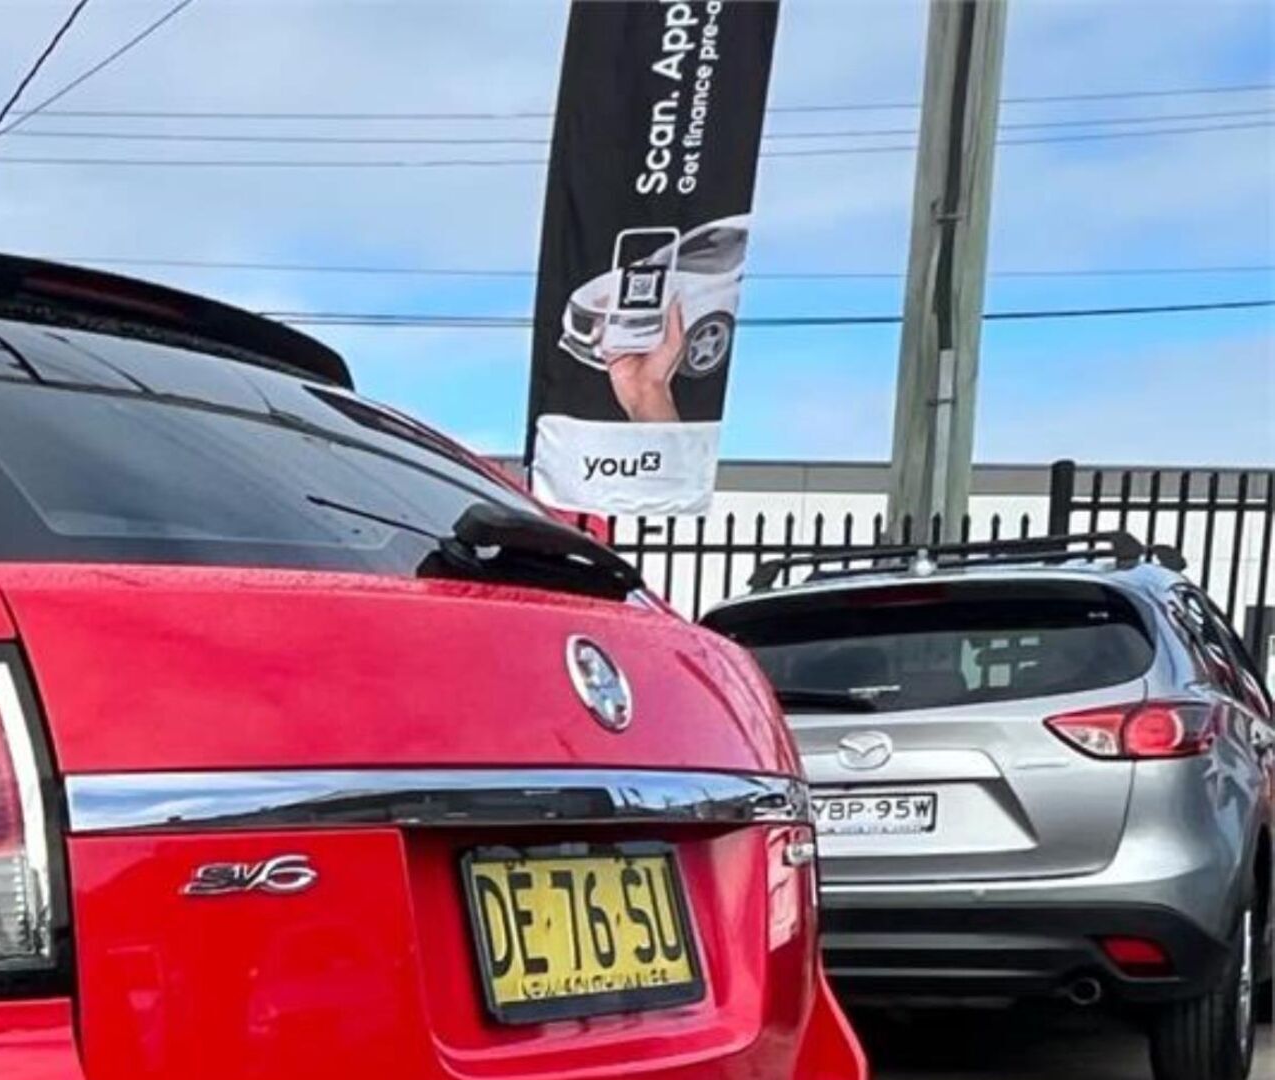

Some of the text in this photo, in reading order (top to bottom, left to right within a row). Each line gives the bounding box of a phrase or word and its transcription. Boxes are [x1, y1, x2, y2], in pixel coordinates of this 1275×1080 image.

[682, 65, 714, 148] finance
[636, 90, 681, 194] Scan.
[677, 152, 701, 194] Get
[179, 854, 317, 895] SV6
